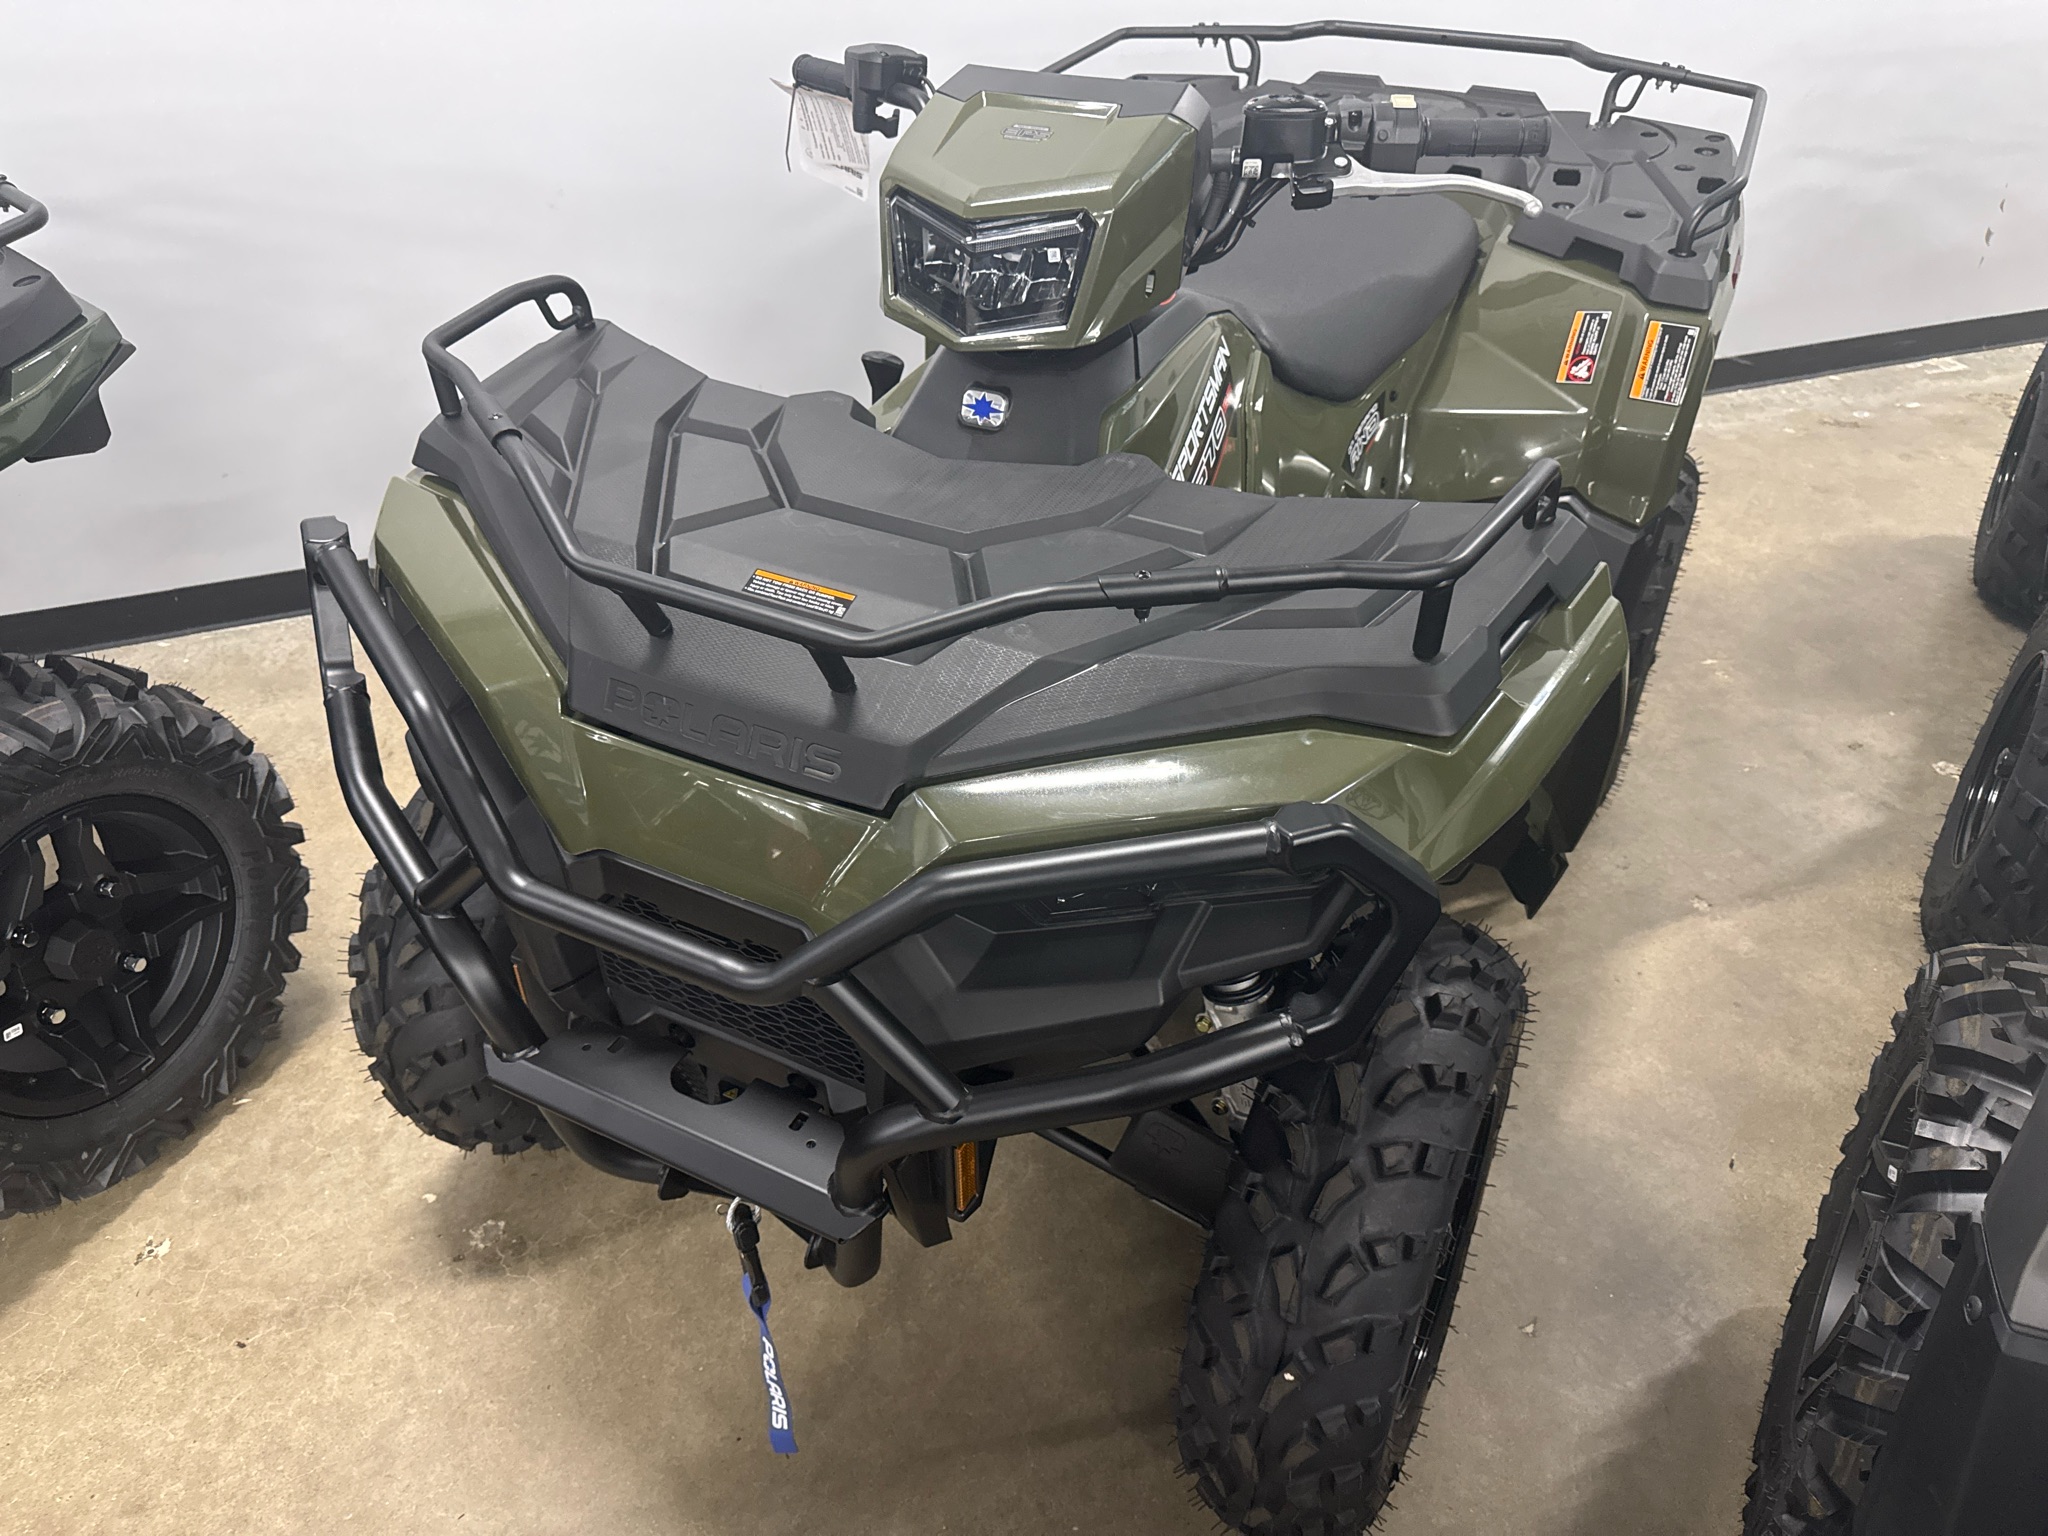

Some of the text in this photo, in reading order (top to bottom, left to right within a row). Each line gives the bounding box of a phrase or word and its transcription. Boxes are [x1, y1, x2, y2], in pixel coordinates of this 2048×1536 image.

[1640, 340, 1654, 372] WARNING
[794, 580, 820, 591] WARNING
[603, 677, 842, 783] POLARIS
[762, 1336, 788, 1430] POLARIS
